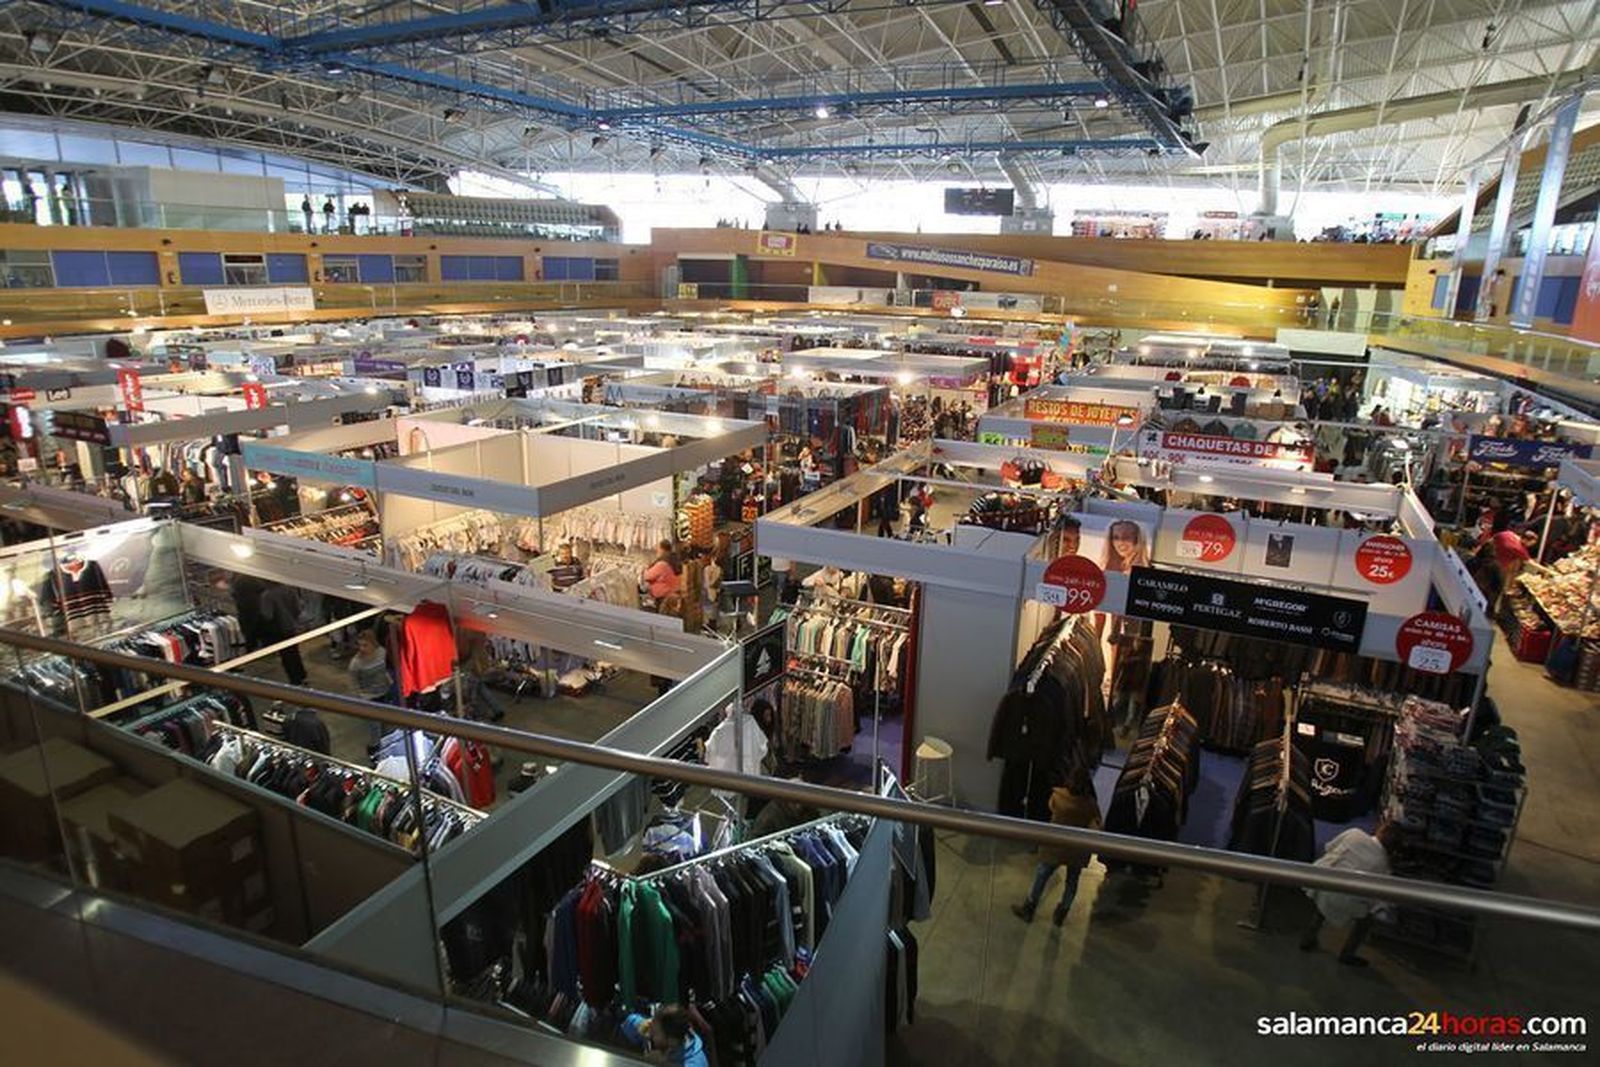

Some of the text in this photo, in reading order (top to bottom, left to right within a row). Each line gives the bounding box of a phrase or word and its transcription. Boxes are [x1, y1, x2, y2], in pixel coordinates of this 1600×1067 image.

[1028, 399, 1067, 415] RESTOS
[1071, 403, 1084, 416] DE
[1167, 436, 1251, 455] CHAQUETAS
[1254, 444, 1274, 456] DE
[1136, 578, 1189, 593] CARAMELO
[1192, 602, 1242, 618] PERTEGAZ
[1414, 618, 1462, 634] CAMISAS
